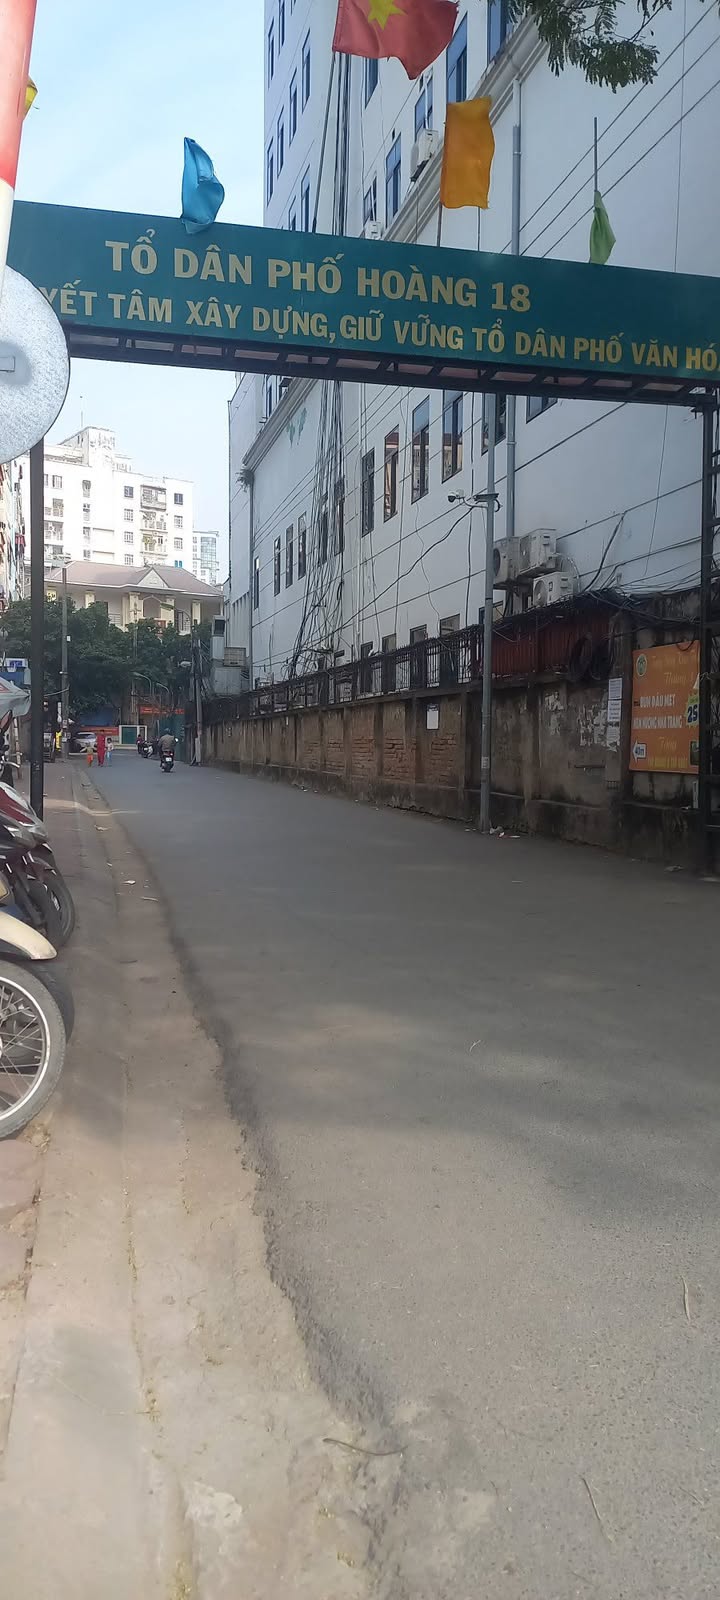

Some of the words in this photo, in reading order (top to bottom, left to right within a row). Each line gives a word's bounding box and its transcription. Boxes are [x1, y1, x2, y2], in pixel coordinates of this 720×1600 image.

[105, 228, 158, 275] TỔ
[173, 244, 252, 285] DÂN
[267, 253, 344, 294] PHỐ
[357, 265, 477, 307] HOÀNG
[492, 281, 531, 312] 18
[107, 288, 172, 323] TÂM
[185, 296, 242, 329] XÂY
[393, 314, 463, 350] VỮNG
[471, 318, 506, 352] TỔ
[515, 328, 565, 359] DÂN
[573, 332, 625, 364] PHỐ
[632, 338, 679, 368] VĂN
[686, 343, 720, 371] HÓ
